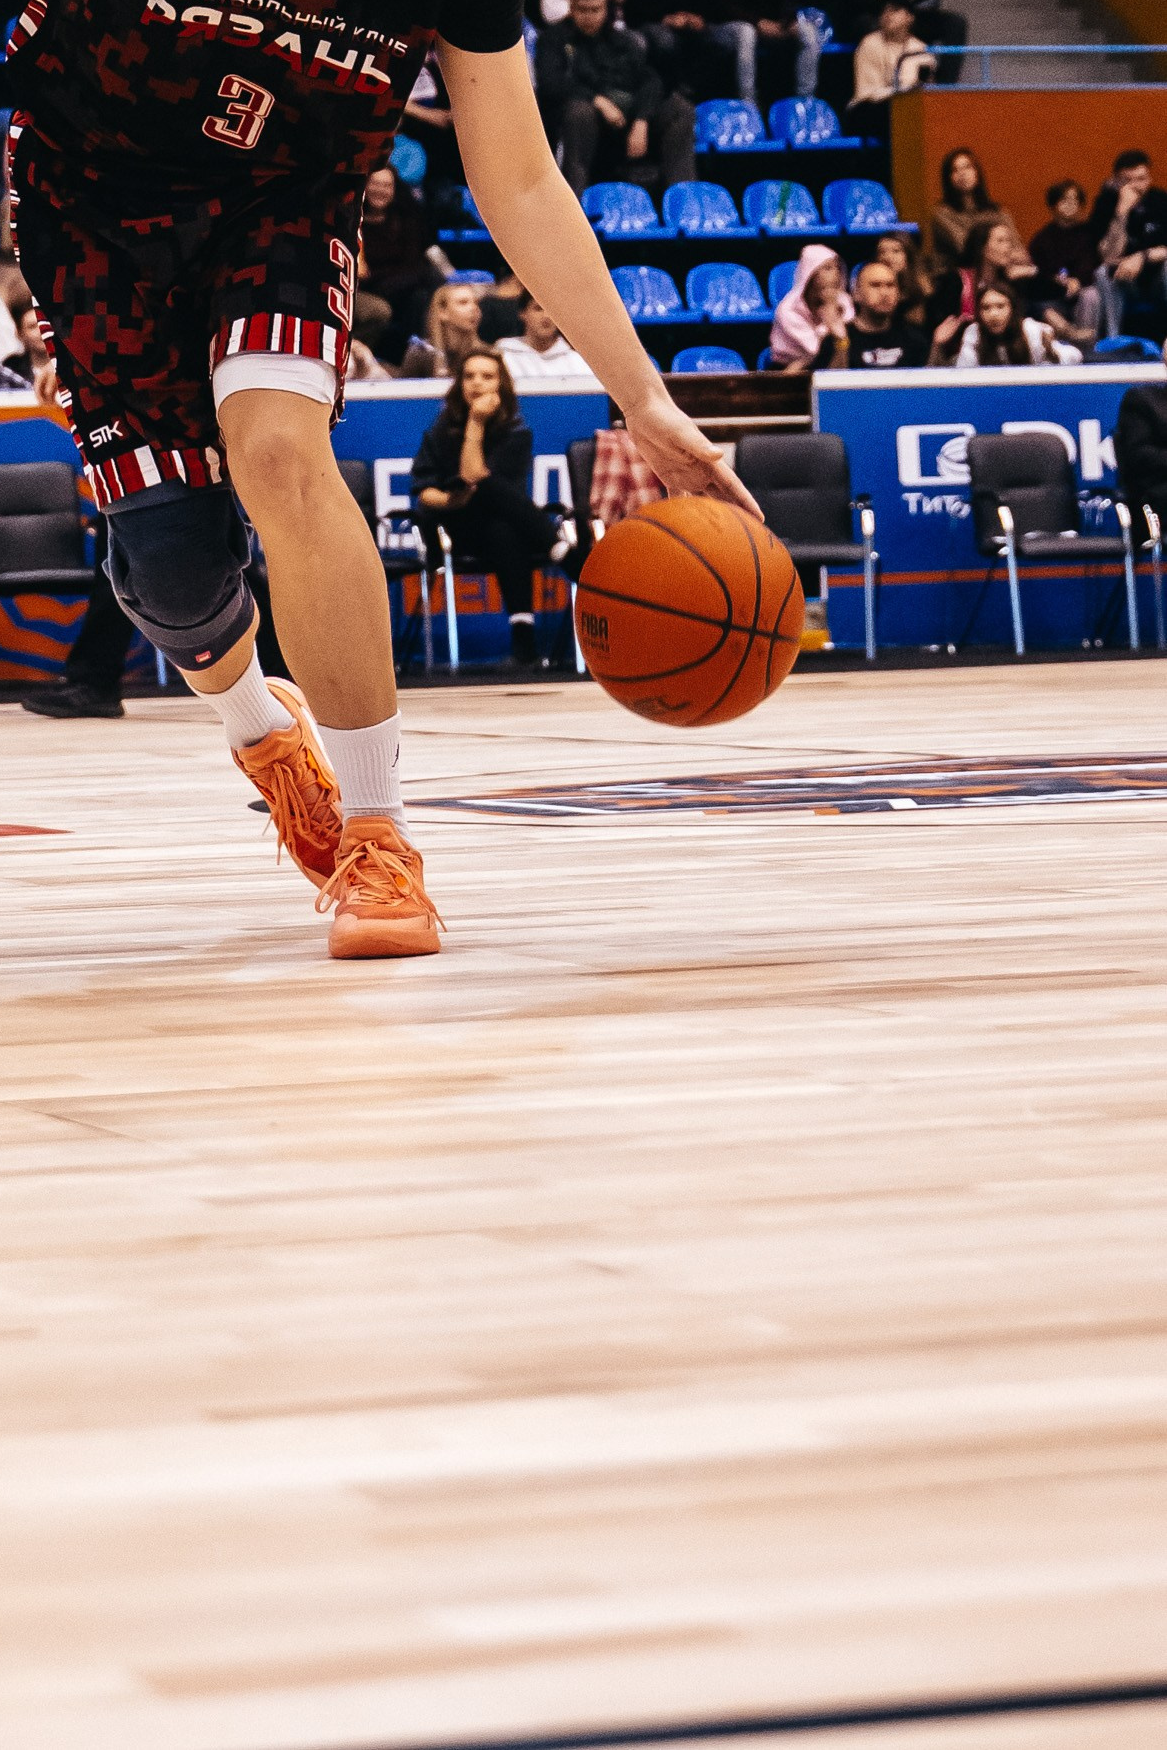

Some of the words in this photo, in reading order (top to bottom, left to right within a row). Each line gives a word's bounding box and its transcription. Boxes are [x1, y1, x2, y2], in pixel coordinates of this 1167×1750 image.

[352, 25, 409, 58] КЛУБ
[201, 73, 276, 150] 3
[327, 238, 355, 332] 3
[89, 420, 124, 448] STK
